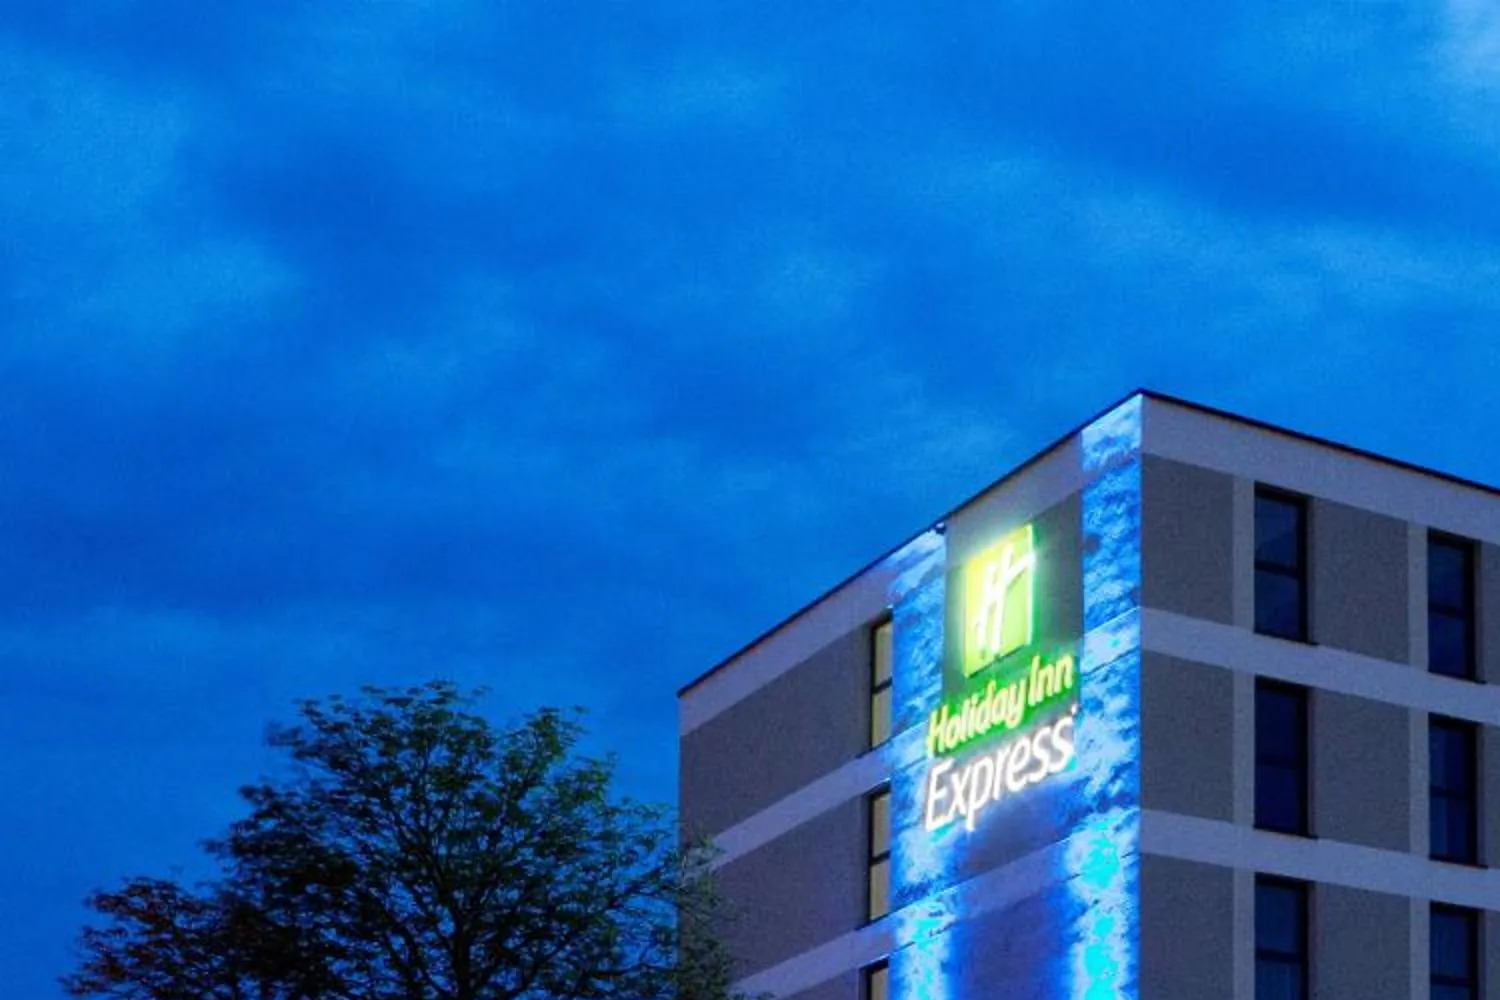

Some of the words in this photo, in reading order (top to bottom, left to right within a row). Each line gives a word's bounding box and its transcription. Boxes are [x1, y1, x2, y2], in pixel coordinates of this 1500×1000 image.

[928, 677, 1027, 755] Holiday
[1027, 653, 1074, 706] Inn
[925, 704, 1077, 832] Express
